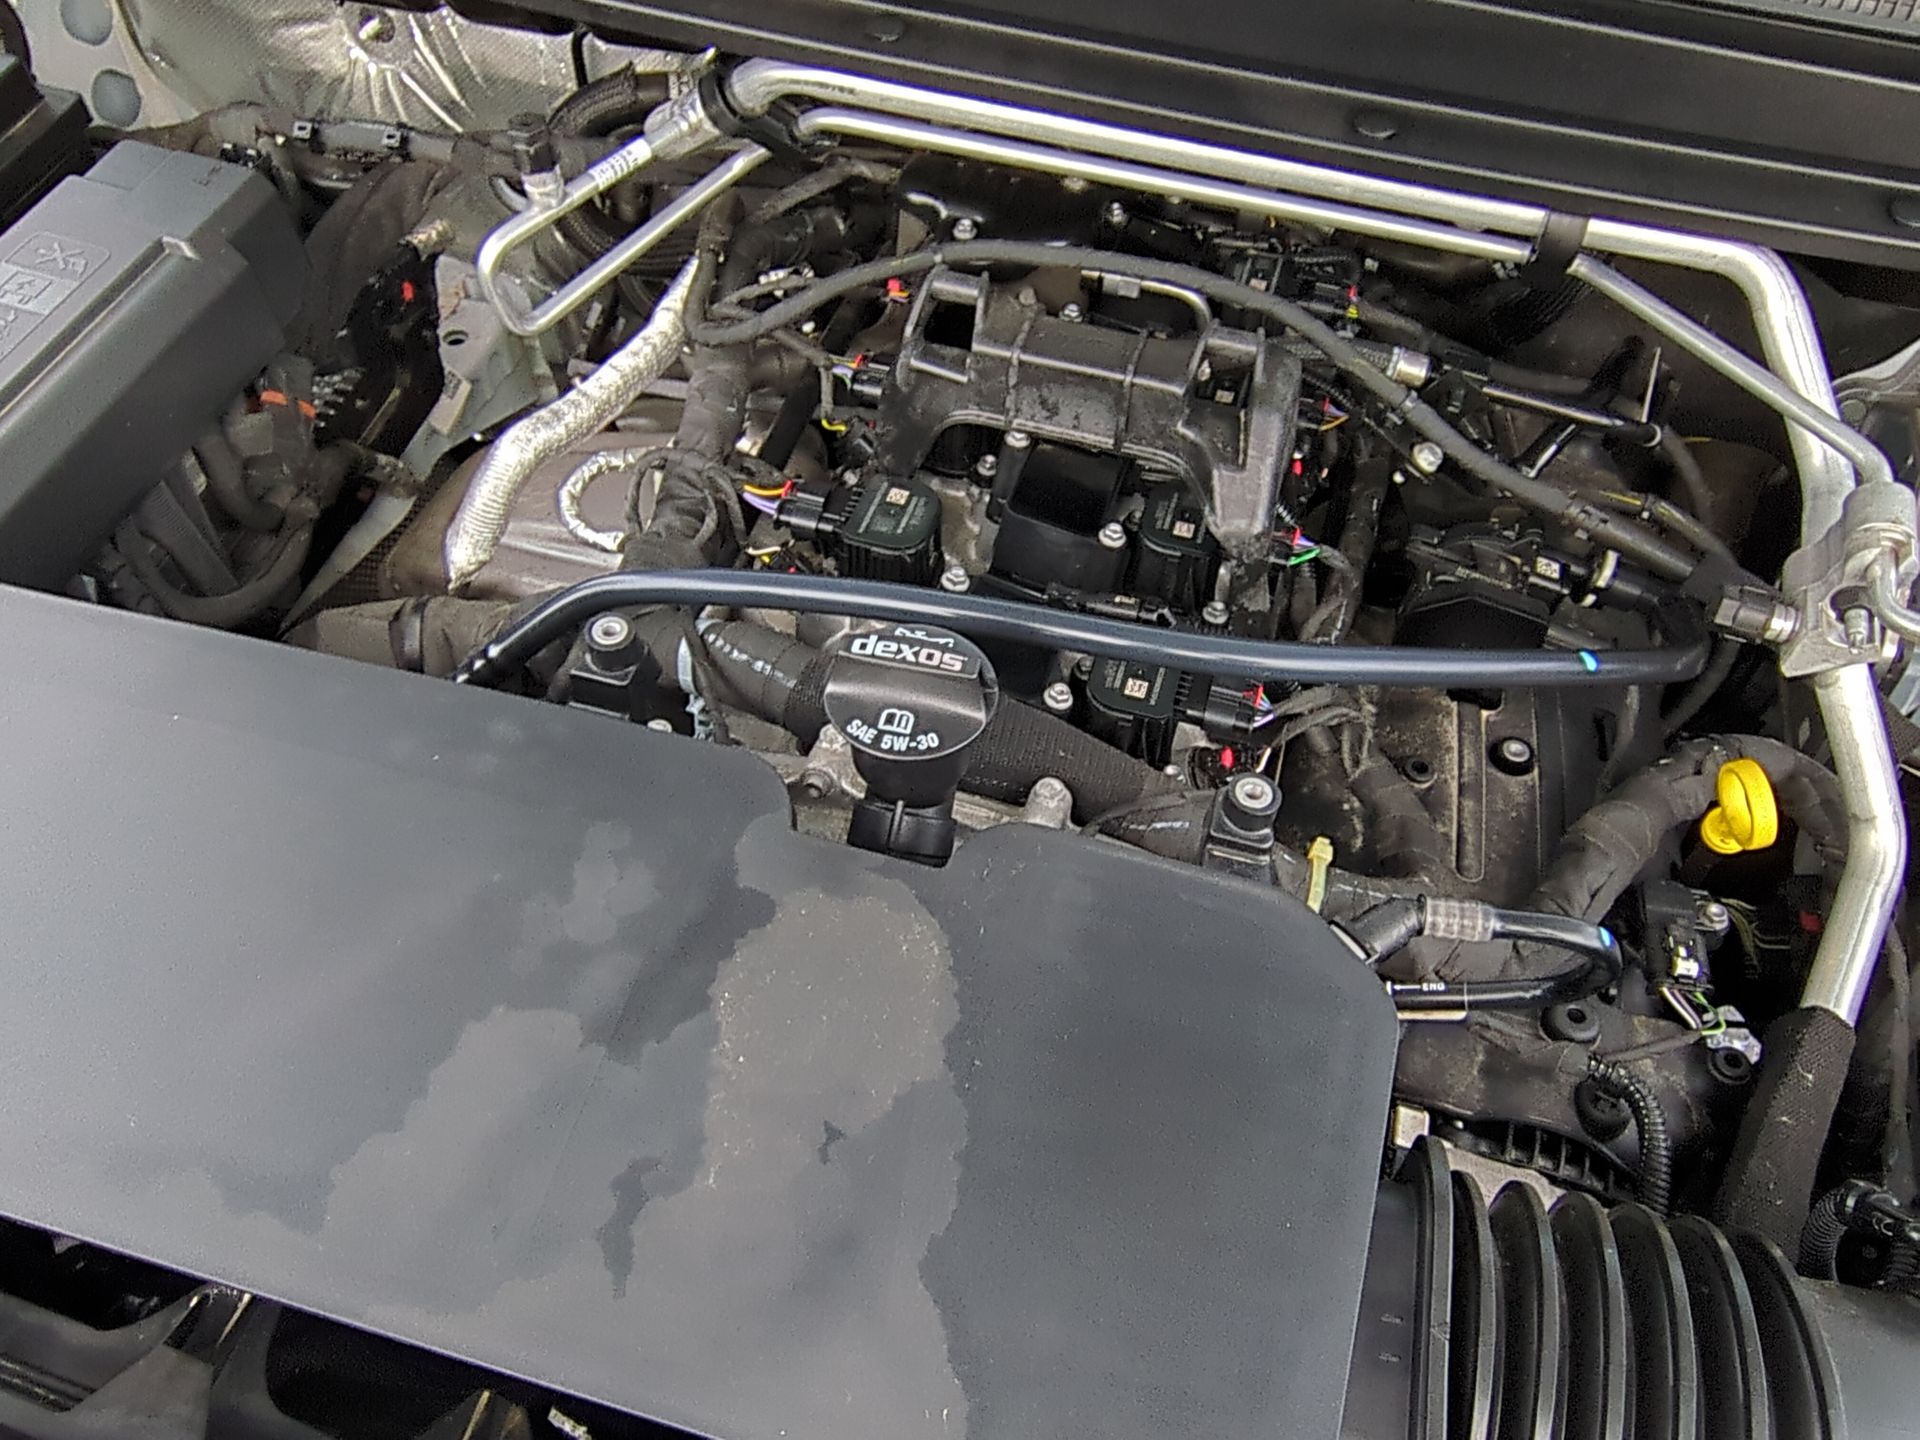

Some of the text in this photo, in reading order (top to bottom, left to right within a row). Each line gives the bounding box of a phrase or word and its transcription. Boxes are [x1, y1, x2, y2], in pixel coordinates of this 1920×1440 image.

[851, 635, 966, 671] dexos
[846, 719, 939, 751] SAE 5W-30
